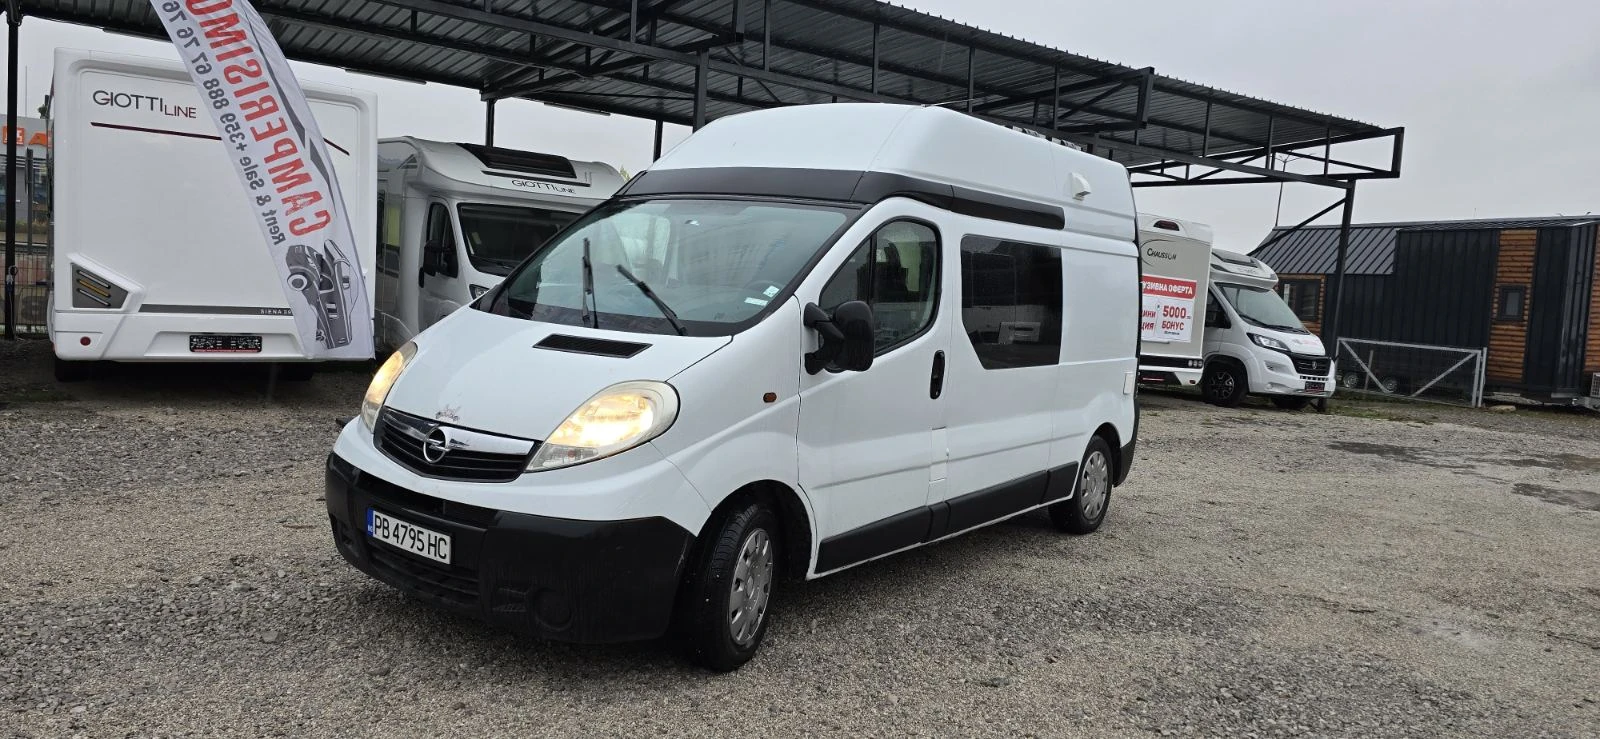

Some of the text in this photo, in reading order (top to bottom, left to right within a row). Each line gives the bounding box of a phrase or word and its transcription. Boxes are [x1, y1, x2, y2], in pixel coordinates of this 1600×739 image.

[1140, 281, 1193, 295] УЗИВНА ОФЕРТА
[1163, 305, 1187, 319] 5000
[1161, 320, 1184, 331] БОНУС
[374, 514, 447, 560] PB 4795 HC
